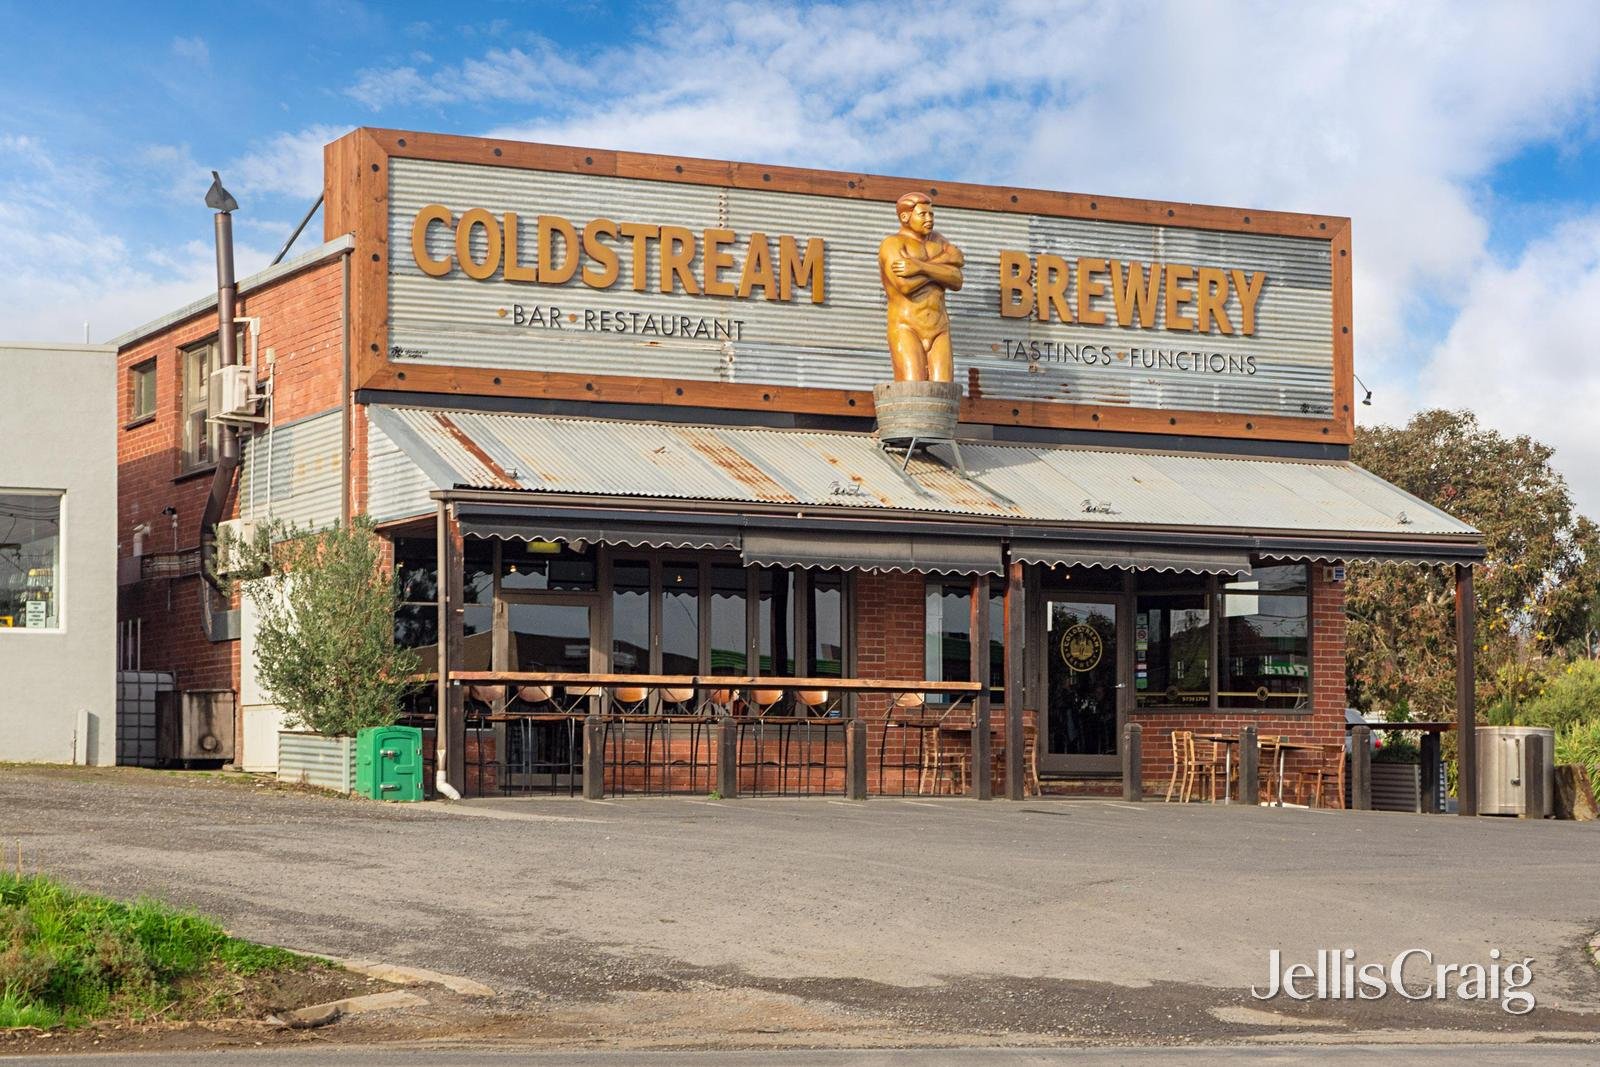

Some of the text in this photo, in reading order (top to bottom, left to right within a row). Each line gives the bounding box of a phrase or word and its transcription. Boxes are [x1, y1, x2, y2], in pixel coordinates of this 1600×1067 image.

[411, 203, 1267, 336] COLDSTREAM BREWERY
[513, 304, 745, 342] BAR RESTAURANT
[1003, 338, 1257, 375] TASTINGS FUNCTIONS
